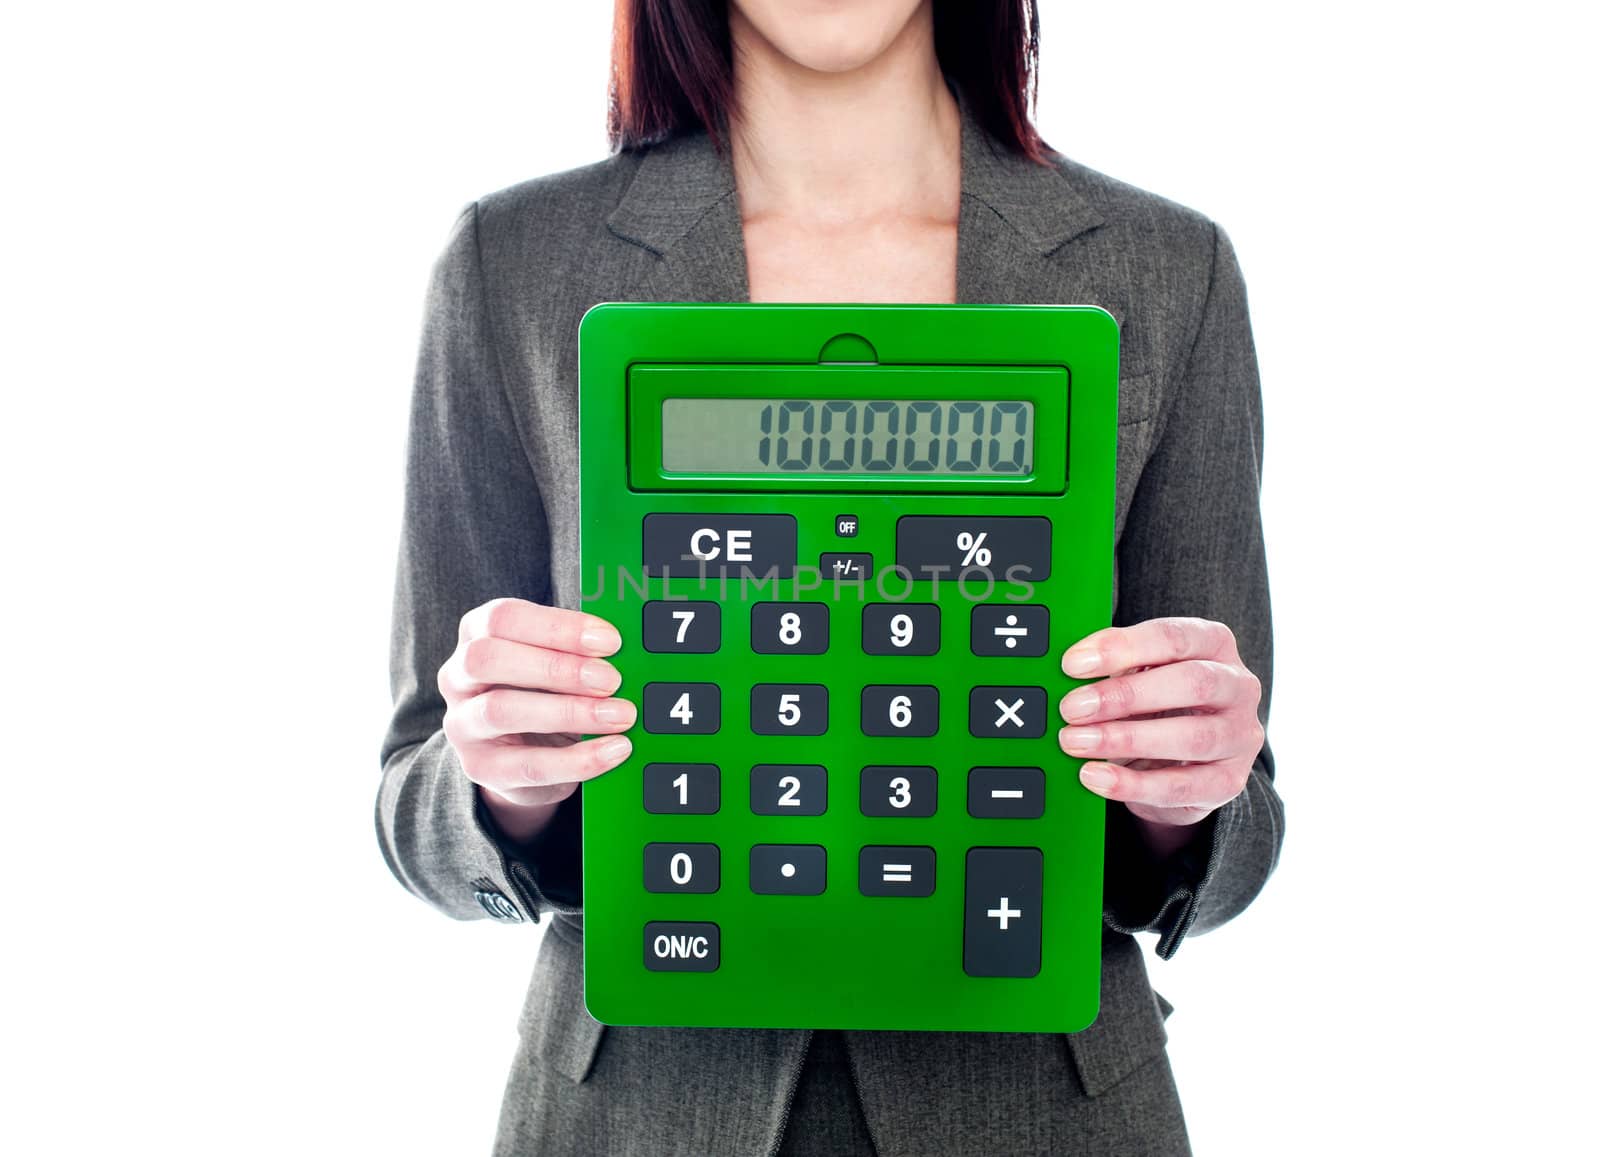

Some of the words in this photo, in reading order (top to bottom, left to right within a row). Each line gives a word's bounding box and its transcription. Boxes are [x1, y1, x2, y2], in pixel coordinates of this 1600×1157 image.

[839, 521, 856, 534] OFF
[690, 528, 753, 562] CE
[956, 532, 992, 567] %
[673, 611, 695, 643] 7
[778, 612, 802, 645] 8
[890, 613, 914, 648] 9
[669, 692, 694, 725] 4
[778, 694, 801, 726] 5
[889, 695, 912, 728] 6
[672, 773, 688, 805] 1
[777, 775, 801, 807] 2
[888, 776, 912, 809] 3
[670, 852, 693, 885] 0
[653, 934, 709, 959] ON/C
